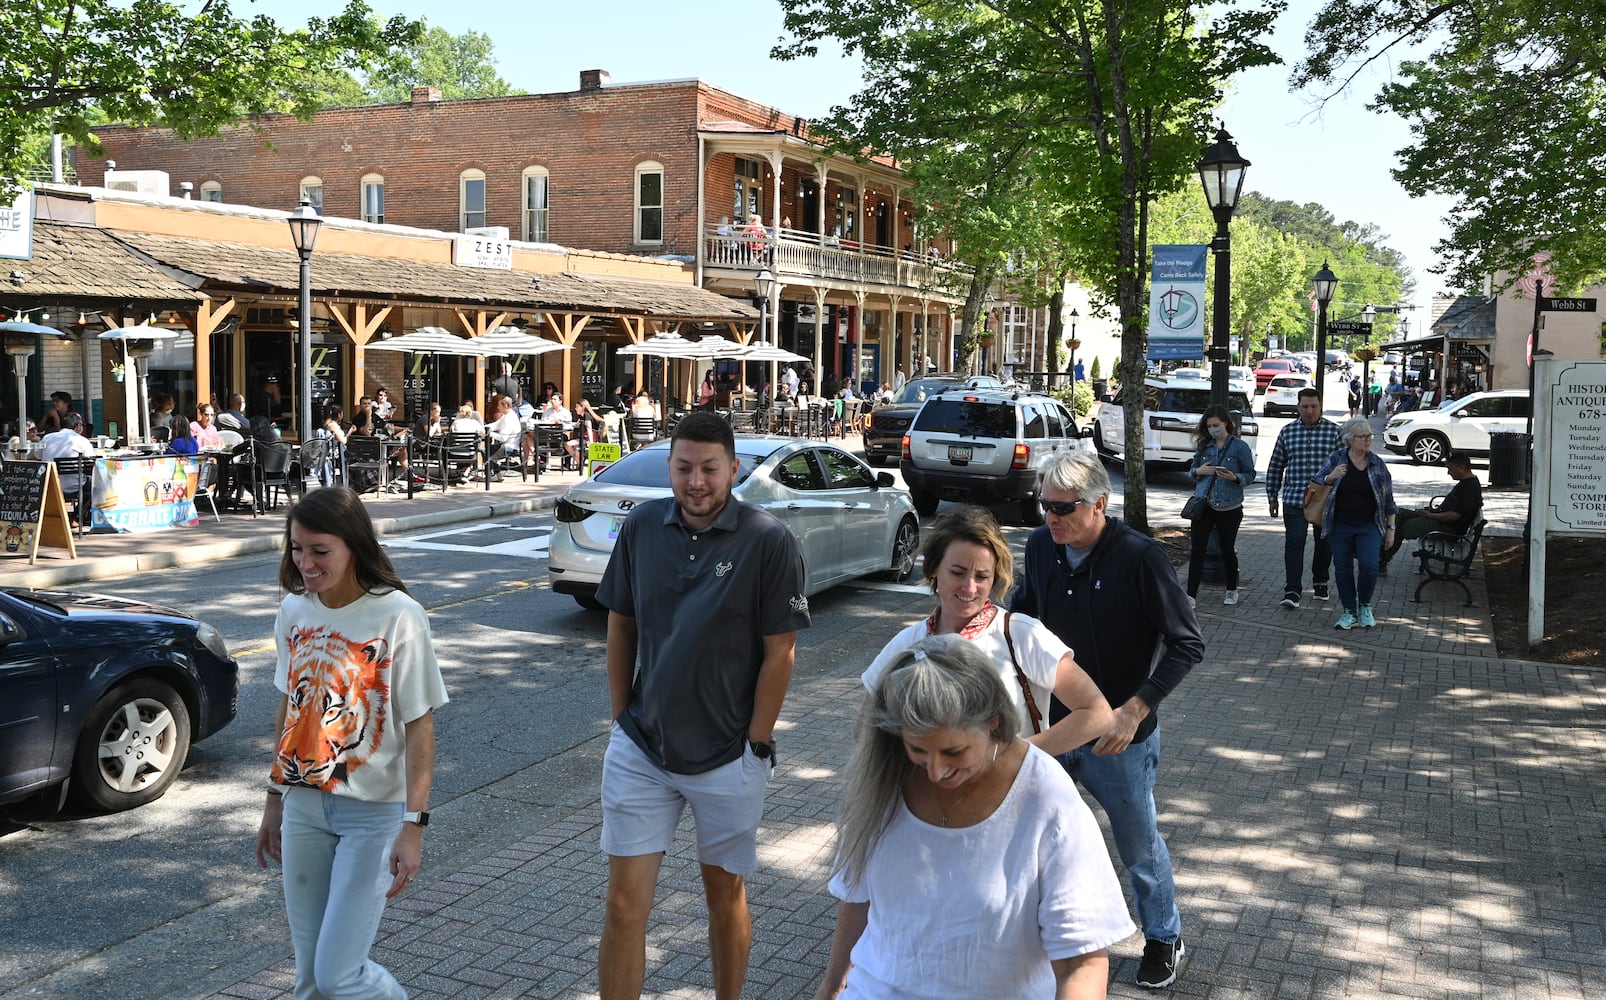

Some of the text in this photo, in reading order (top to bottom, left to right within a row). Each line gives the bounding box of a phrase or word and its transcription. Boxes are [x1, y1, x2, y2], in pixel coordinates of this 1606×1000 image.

[475, 241, 512, 255] ZEST
[1551, 300, 1586, 310] Webb St
[581, 375, 602, 384] ZEST
[1568, 384, 1606, 394] HISTO
[1569, 424, 1601, 433] Monday
[1569, 434, 1601, 443] Tuesday
[594, 445, 614, 453] STATE
[1568, 453, 1604, 462] Thursday
[1567, 463, 1593, 472] Friday
[1567, 473, 1602, 482] Saturday
[1567, 482, 1597, 491] Sunday
[0, 510, 28, 521] TEQUILA
[94, 507, 170, 525] CELEBRATE
